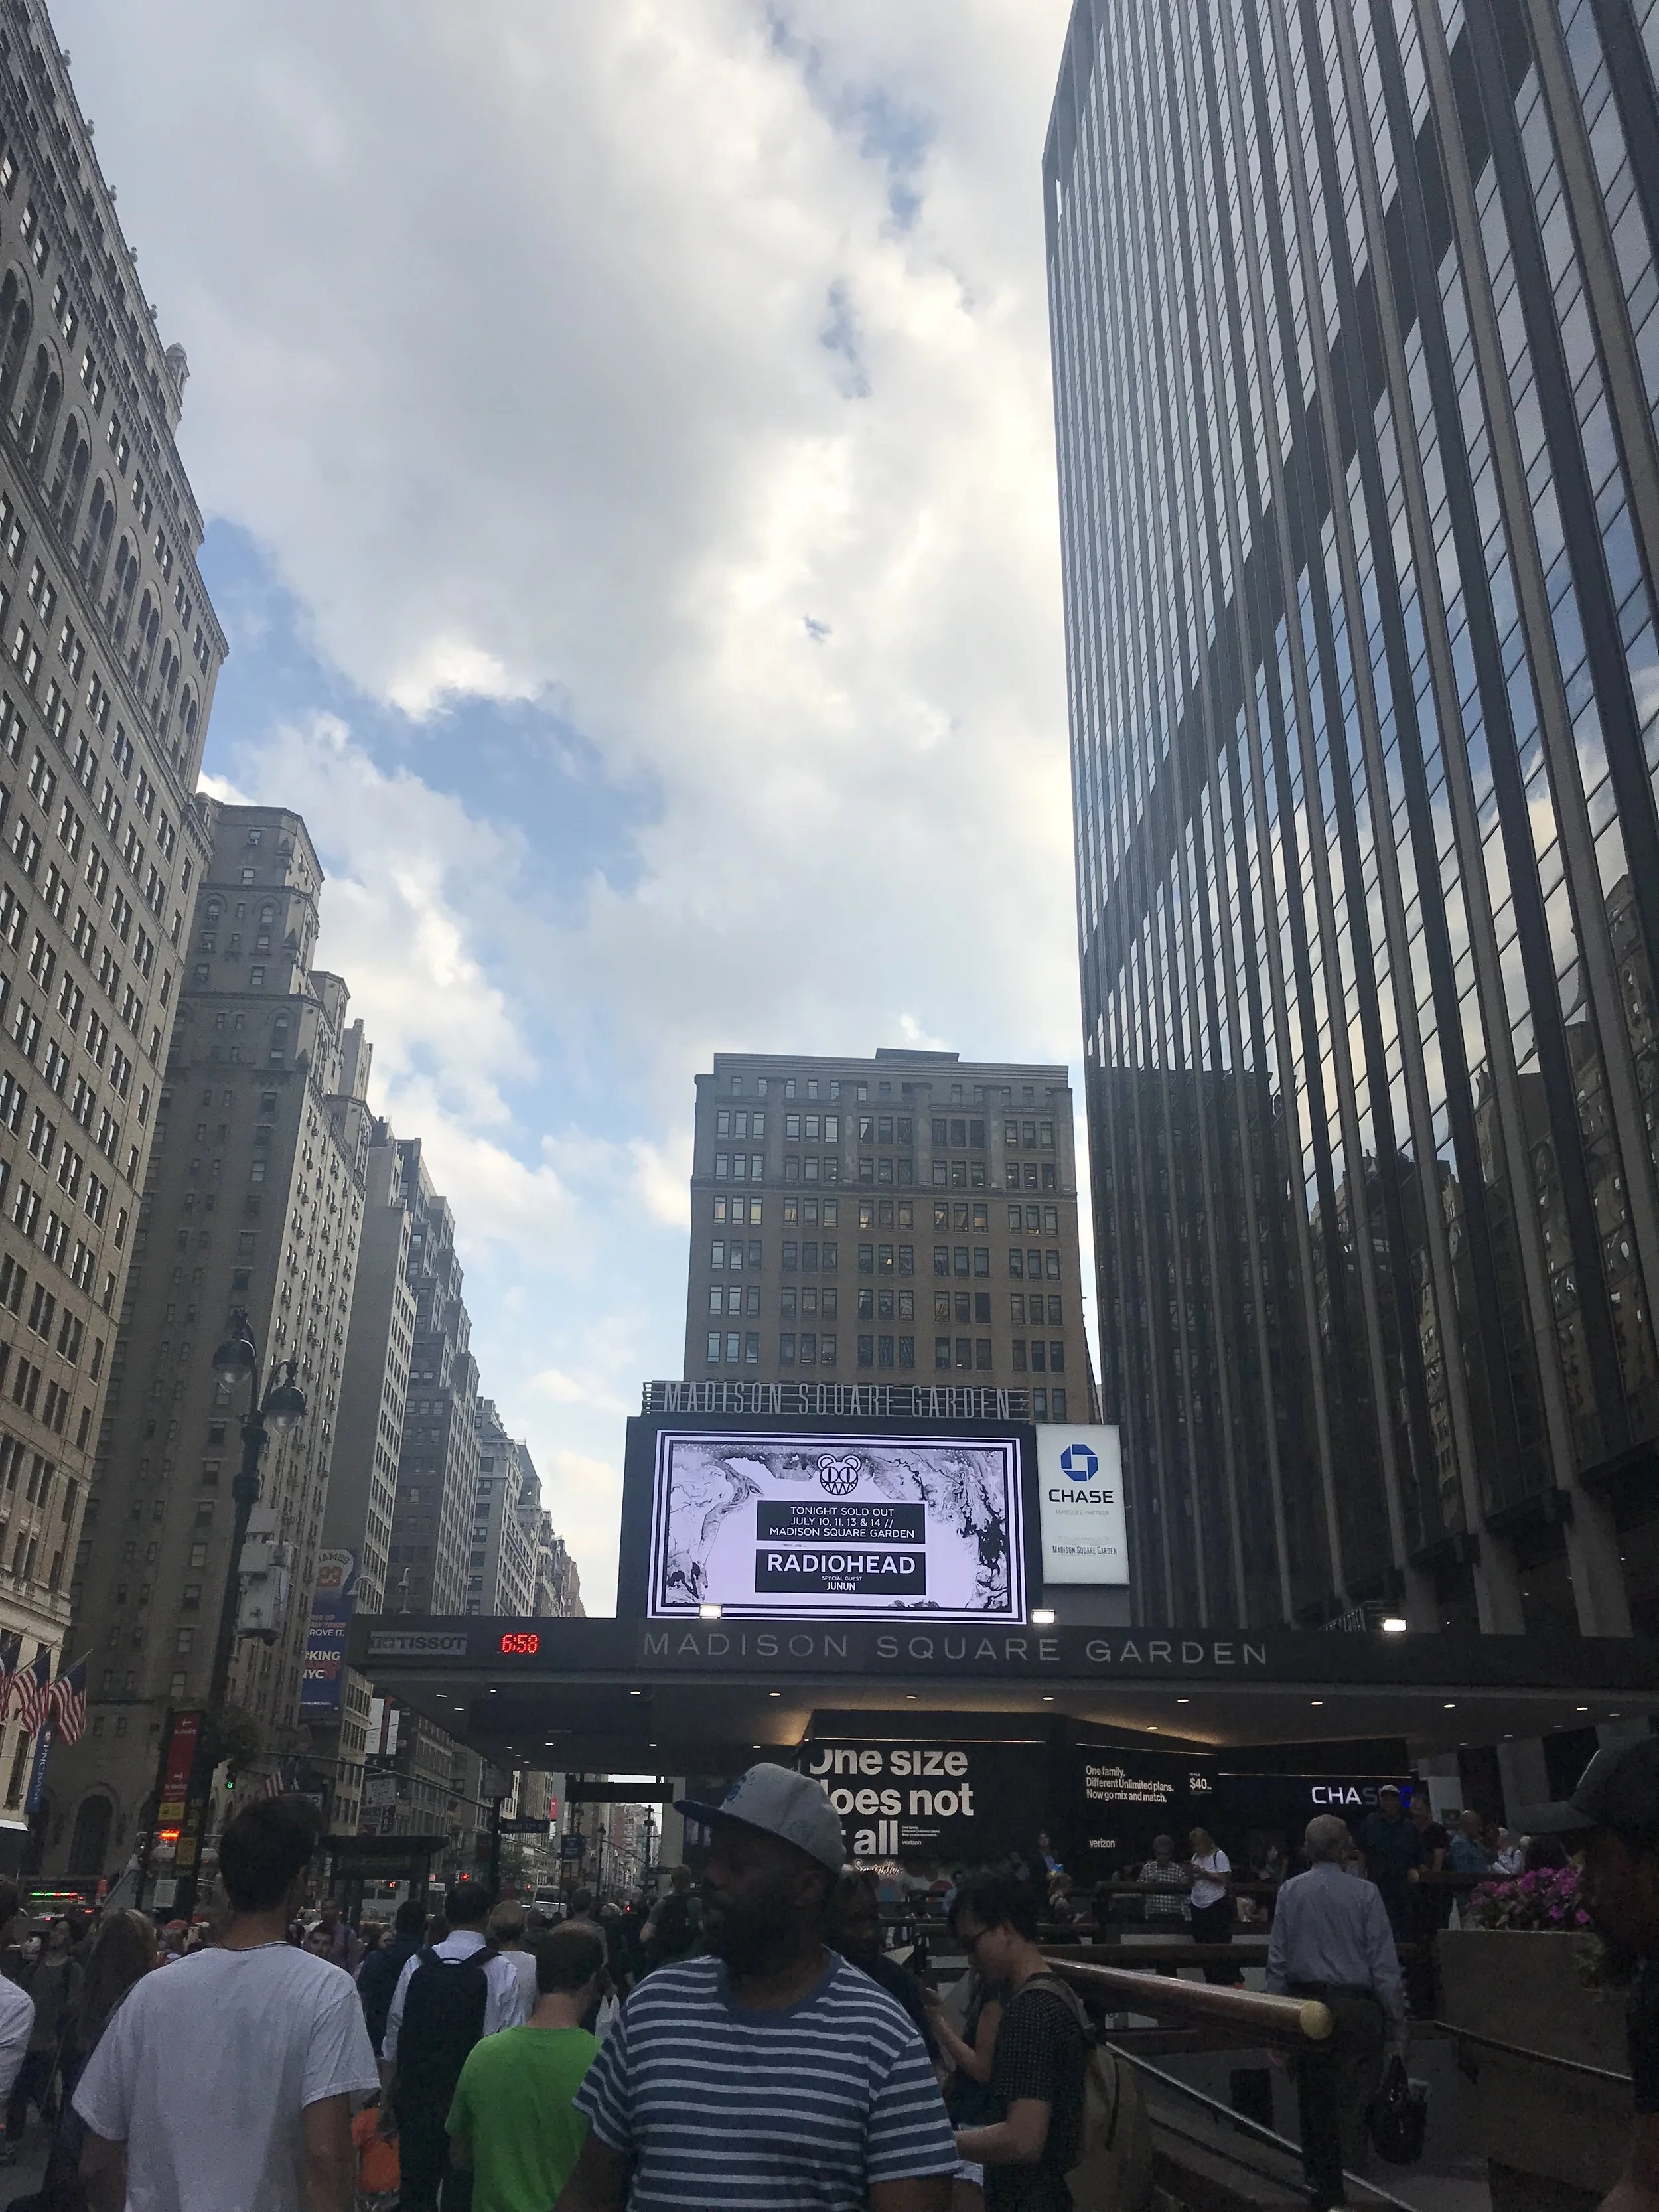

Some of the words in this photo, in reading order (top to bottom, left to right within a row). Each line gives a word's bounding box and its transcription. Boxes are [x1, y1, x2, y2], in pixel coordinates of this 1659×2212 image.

[664, 1380, 782, 1414] MADISON
[798, 1383, 894, 1417] SQUARE
[911, 1386, 1009, 1420] GARDEN
[1048, 1489, 1114, 1503] CHASE
[790, 1506, 837, 1516] TONIGHT
[841, 1507, 869, 1516] SOLD
[873, 1508, 894, 1517] OUT
[790, 1517, 815, 1526] JULY
[819, 1518, 831, 1526] 10,
[847, 1518, 857, 1526] 13
[860, 1518, 867, 1527] &
[871, 1518, 881, 1527] 14
[770, 1527, 820, 1536] MADISON
[824, 1528, 866, 1538] SQUARE
[870, 1529, 915, 1538] GARDEN
[319, 1553, 350, 1565] JAMES
[768, 1554, 916, 1574] RADIOHEAD
[317, 1566, 343, 1587] 23
[826, 1582, 855, 1591] JUNUN
[396, 1636, 467, 1649] TISSOT
[501, 1633, 539, 1653] 6:58
[643, 1633, 848, 1658] MADISON
[877, 1636, 1061, 1662] SQUARE
[1086, 1639, 1267, 1664] GARDEN
[890, 1750, 968, 1777] size
[1086, 1765, 1101, 1775] One
[1102, 1766, 1125, 1779] family.
[1086, 1777, 1118, 1787] Different
[1119, 1779, 1153, 1790] Unlimited
[1153, 1781, 1174, 1792] plans.
[1190, 1777, 1207, 1791] $40
[820, 1779, 902, 1816] oes
[909, 1783, 974, 1817] not
[1086, 1789, 1104, 1799] Now
[1104, 1791, 1114, 1801] go
[1114, 1790, 1128, 1800] mix
[1129, 1791, 1142, 1801] and
[1143, 1793, 1167, 1803] match.
[1311, 1786, 1381, 1805] CHAS
[853, 1820, 899, 1855] all
[1089, 1838, 1116, 1848] verizon
